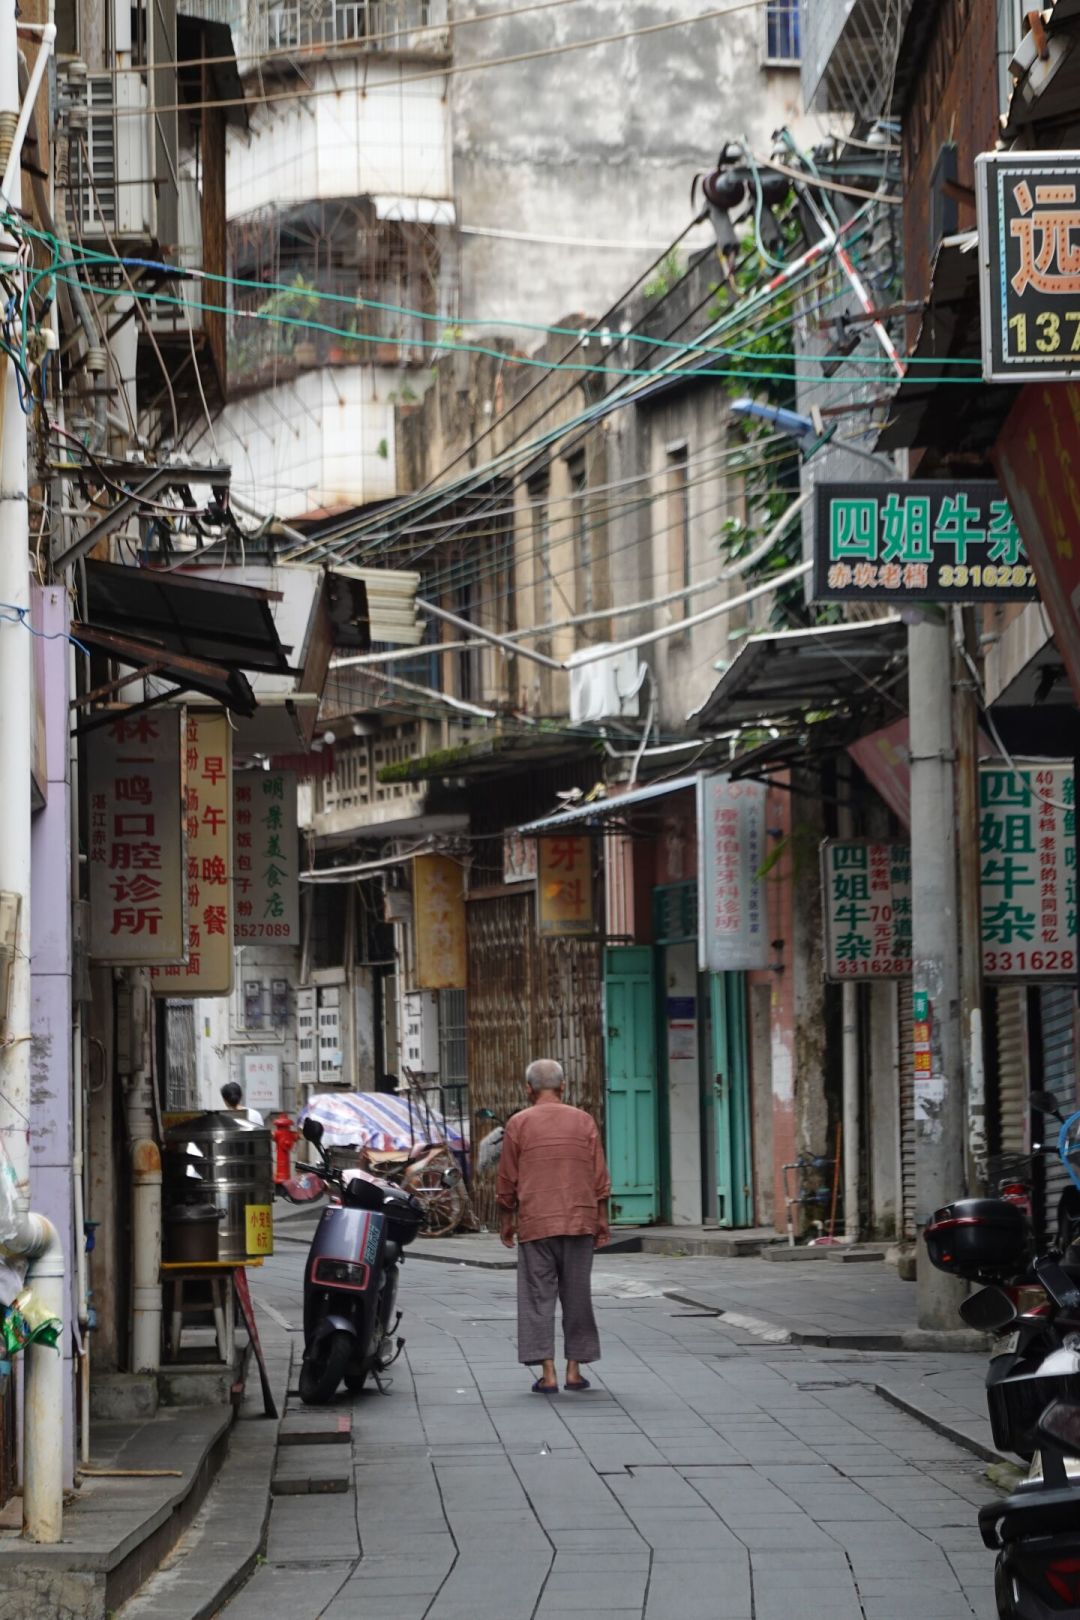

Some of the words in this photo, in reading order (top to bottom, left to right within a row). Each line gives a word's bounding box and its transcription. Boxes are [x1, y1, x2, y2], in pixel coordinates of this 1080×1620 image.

[829, 492, 1029, 565] 四姐牛杂
[108, 714, 163, 936] 林一鸣口腔诊所
[201, 756, 228, 935] 早午晚餐
[979, 770, 1036, 944] 四姐牛杂
[832, 845, 872, 961] 四姐牛杂
[983, 950, 1074, 972] 331628
